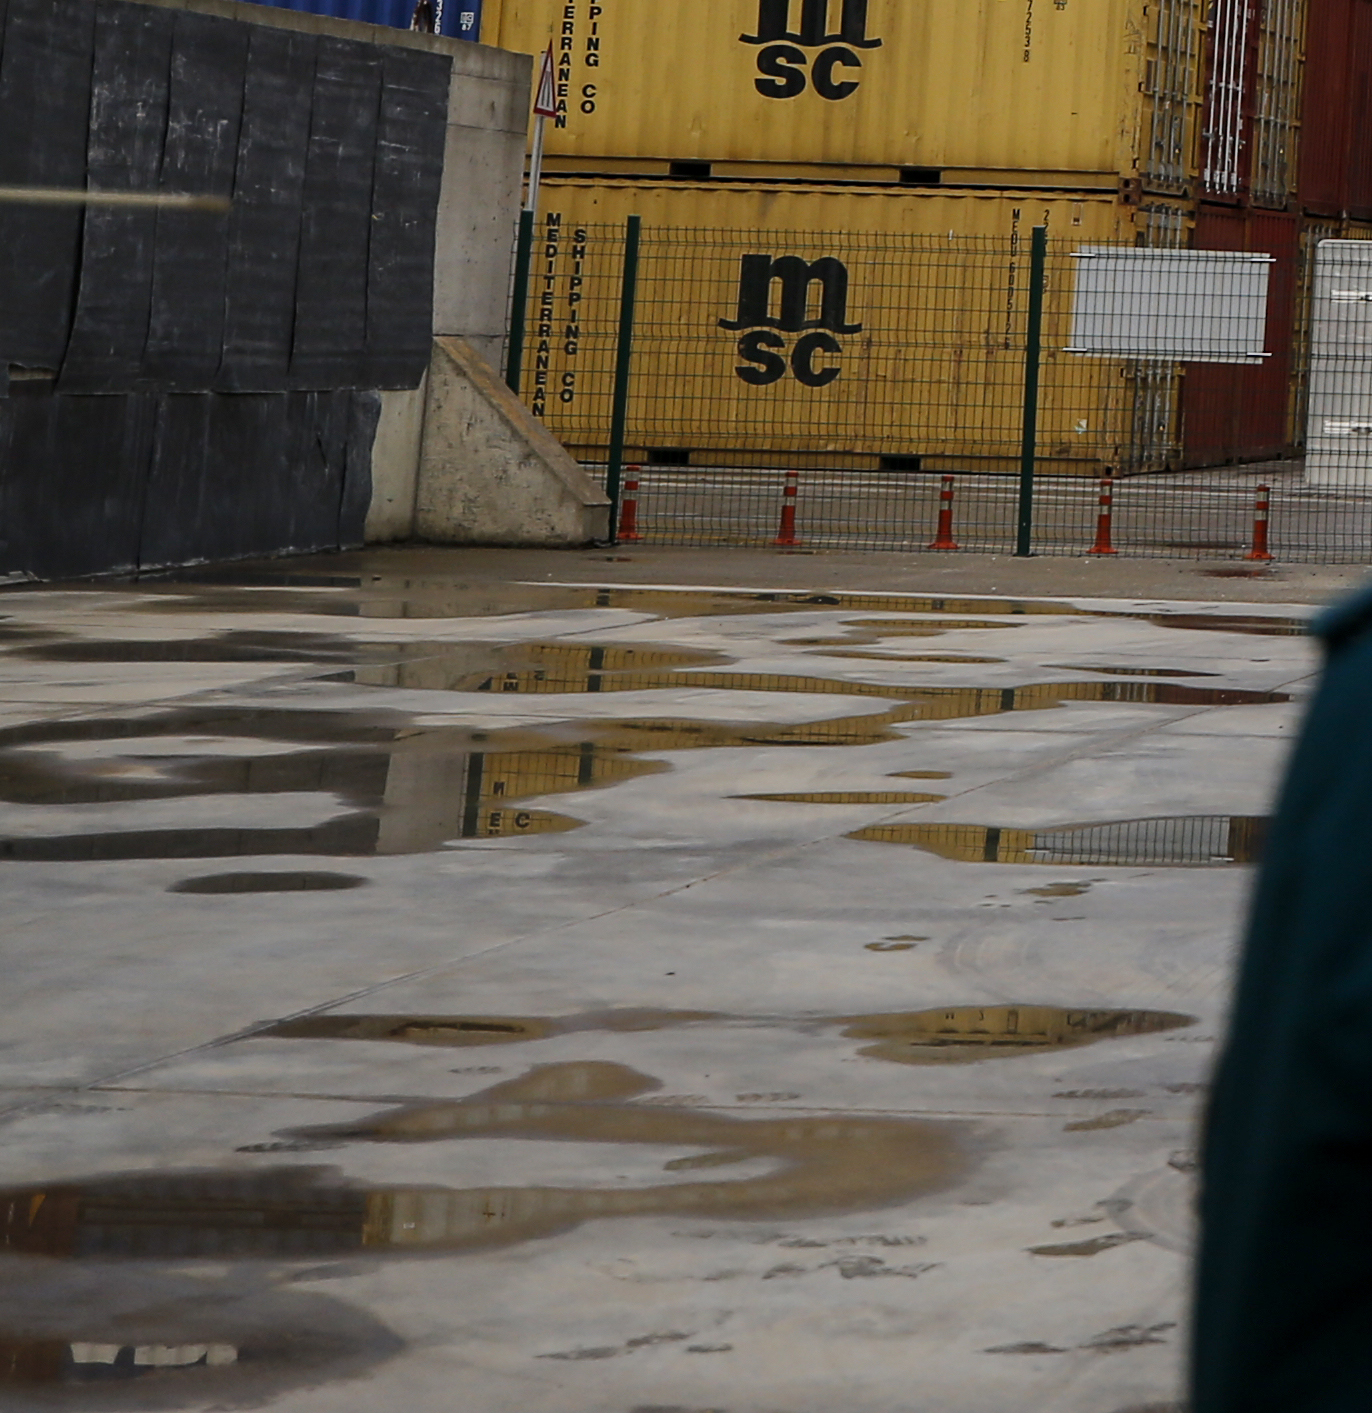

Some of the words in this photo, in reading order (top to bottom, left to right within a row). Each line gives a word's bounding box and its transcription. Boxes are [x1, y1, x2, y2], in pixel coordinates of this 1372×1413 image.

[580, 84, 597, 115] CO
[532, 213, 561, 417] MEDITERRANEAN
[564, 230, 586, 356] SHIPPING
[560, 373, 575, 404] CO
